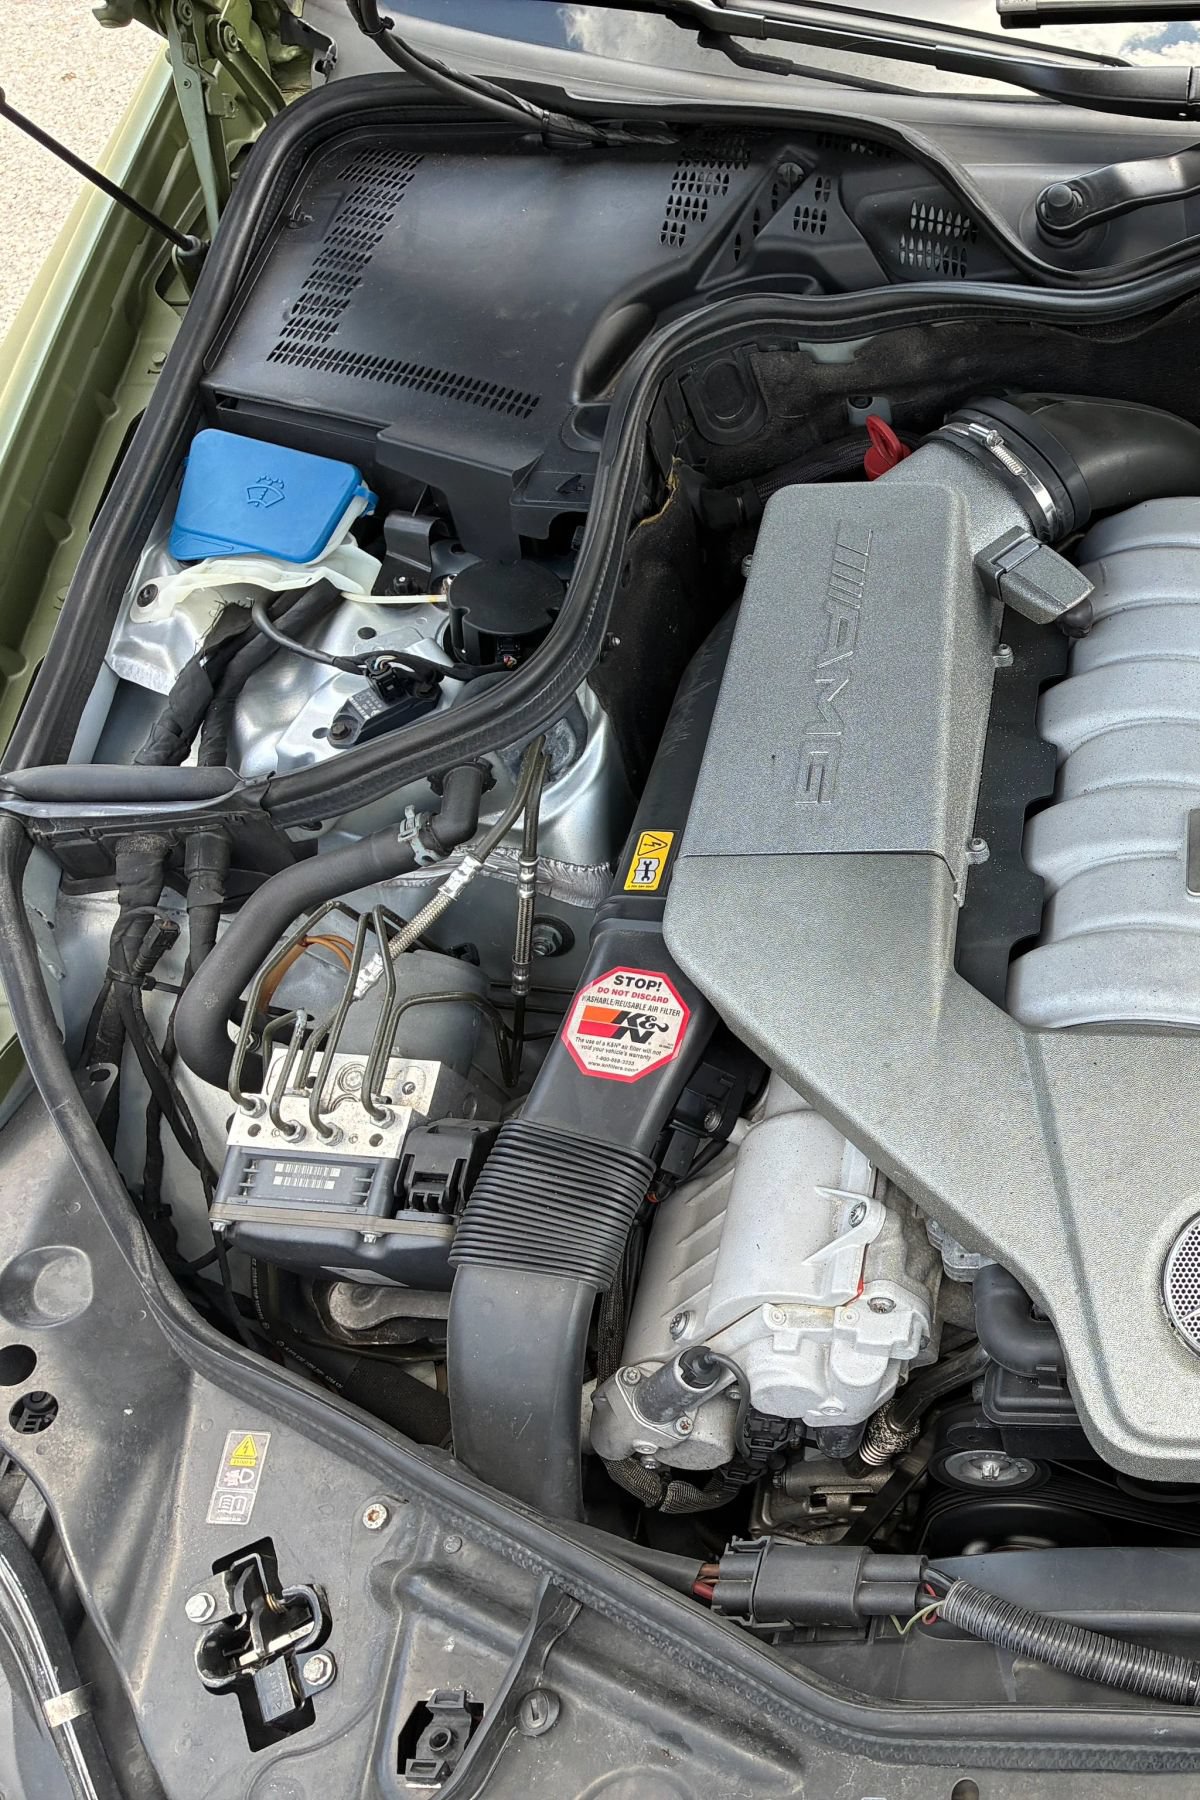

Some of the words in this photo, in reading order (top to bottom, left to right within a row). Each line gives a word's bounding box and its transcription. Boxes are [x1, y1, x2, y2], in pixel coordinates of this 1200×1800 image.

[794, 596, 862, 805] AMG
[613, 974, 663, 992] STOP!
[597, 986, 610, 994] DO
[611, 988, 630, 998] NOT
[631, 991, 669, 1005] DISCARD
[647, 1003, 659, 1013] AIR
[660, 1006, 681, 1017] FILTER
[610, 1009, 670, 1045] K&N
[605, 1048, 628, 1057] vehicle's
[628, 1051, 651, 1062] warranty
[629, 1044, 641, 1052] filter
